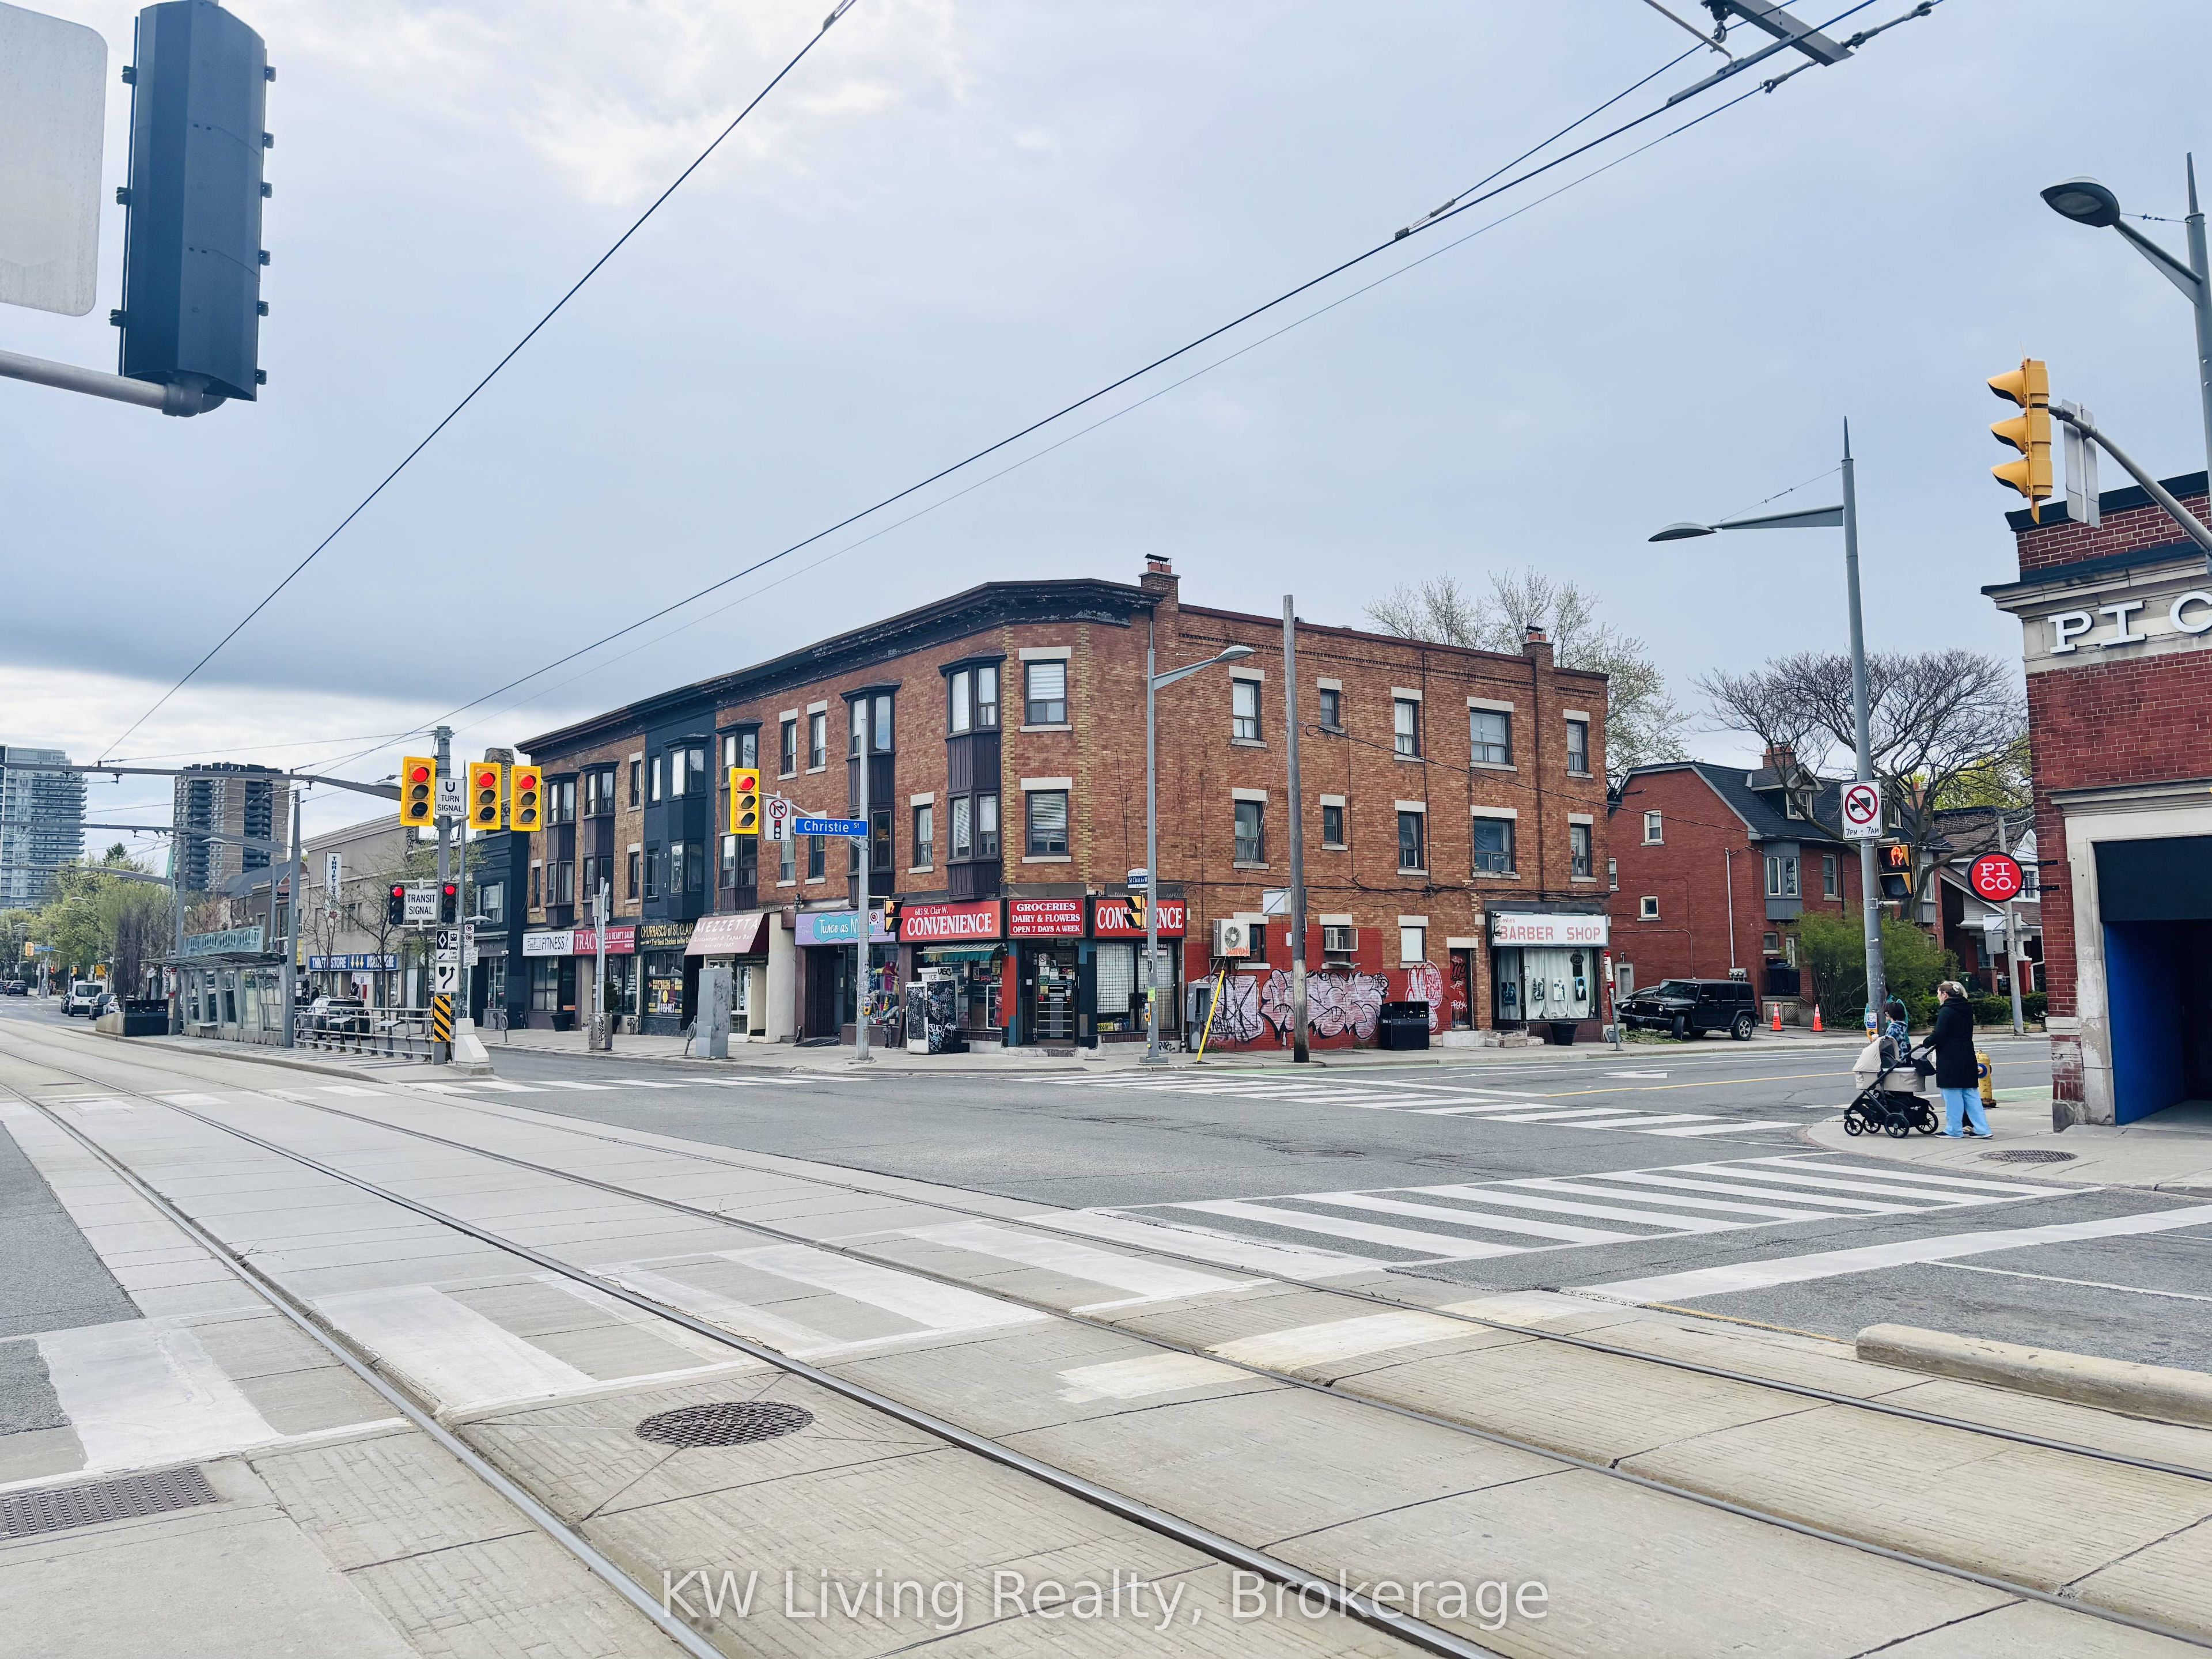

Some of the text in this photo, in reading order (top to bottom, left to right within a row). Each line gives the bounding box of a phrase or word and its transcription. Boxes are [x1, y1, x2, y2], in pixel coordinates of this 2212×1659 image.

[445, 782, 456, 792] U
[437, 804, 463, 812] SIGNAL
[804, 821, 849, 832] Christie
[1846, 828, 1858, 836] 7PM
[1980, 862, 2010, 876] PI
[1980, 877, 2016, 891] CO.
[407, 894, 435, 903] TRANSIT
[409, 906, 433, 915] SIGNAL
[930, 907, 941, 915] Clair
[942, 906, 949, 914] W.
[1016, 902, 1076, 912] GROCERIES
[1012, 914, 1080, 923] DAIRY & FLOWERS
[641, 925, 667, 938] CHURRASCO
[680, 923, 694, 935] CLAIR
[694, 918, 759, 933] MEZZETTA
[819, 919, 839, 935] Twice
[840, 925, 849, 933] as
[907, 913, 993, 937] CONVENIENCE
[1499, 926, 1600, 940] BARBER SHOP
[541, 936, 565, 950] FITNESS
[330, 956, 346, 968] STORE
